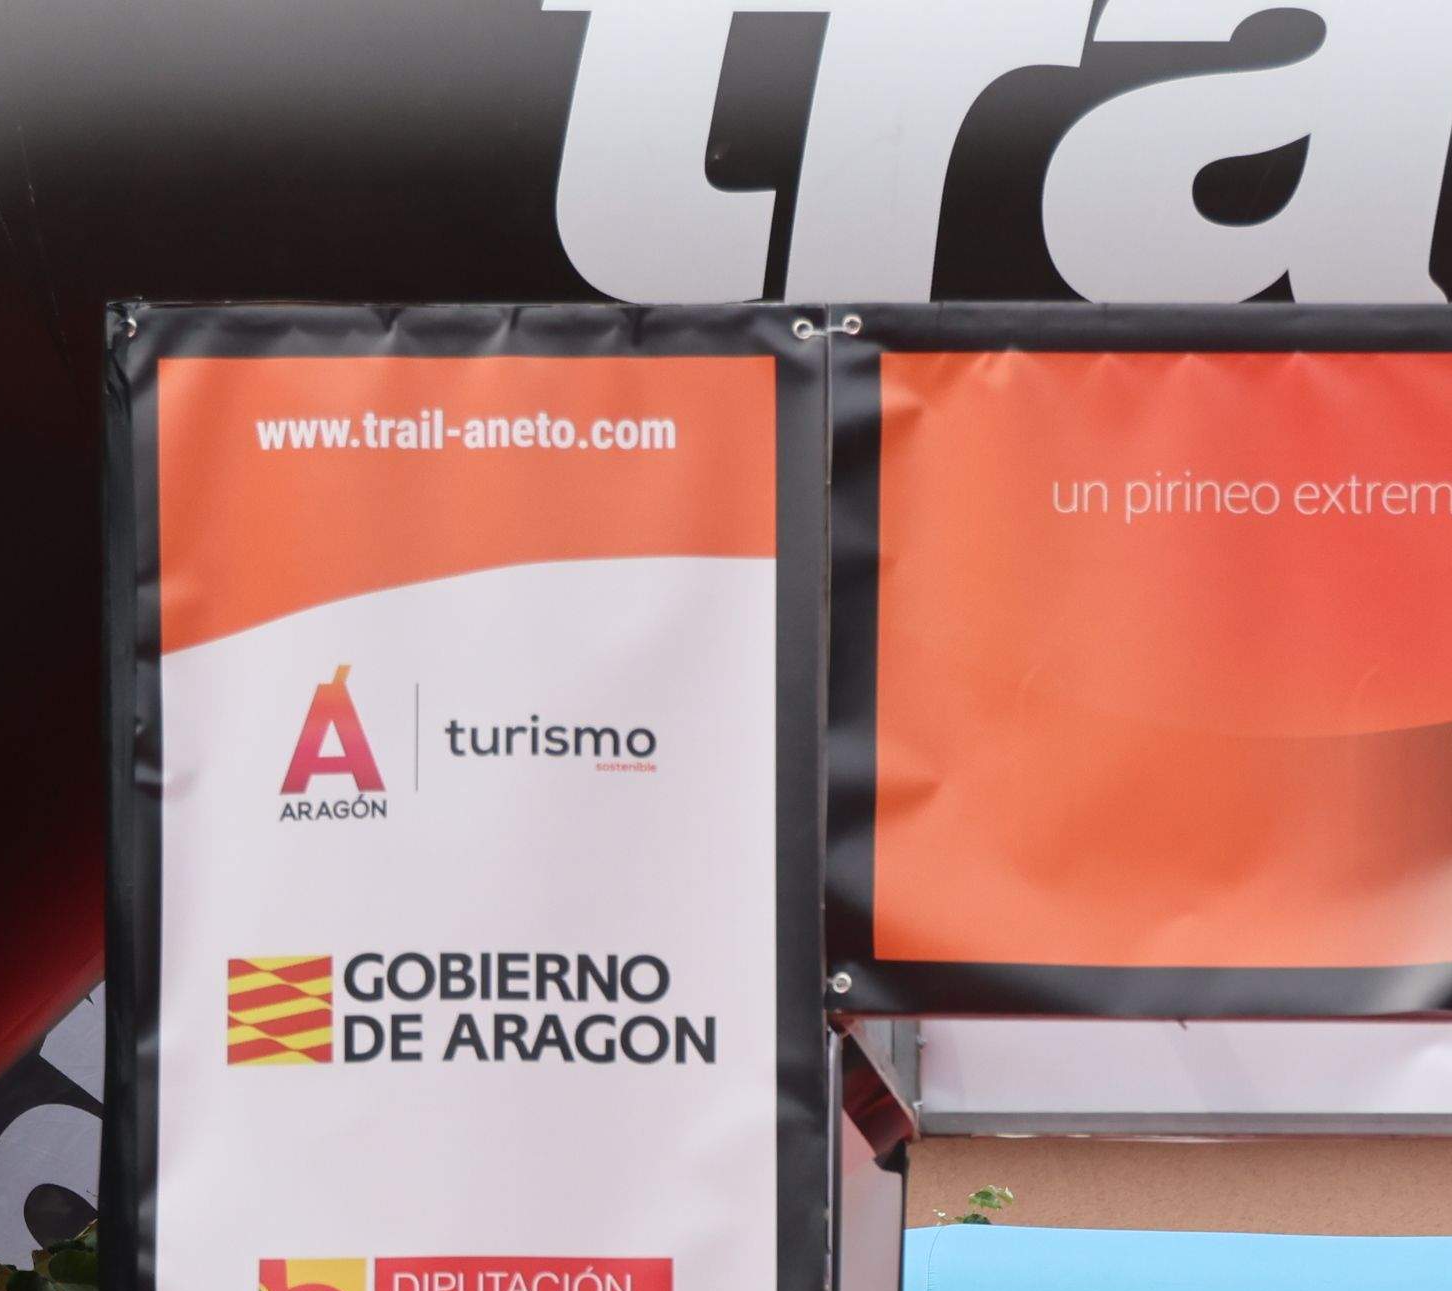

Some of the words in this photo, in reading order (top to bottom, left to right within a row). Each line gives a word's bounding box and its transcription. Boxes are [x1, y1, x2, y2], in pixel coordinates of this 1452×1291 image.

[257, 411, 677, 450] www.trail-aneto.com
[1052, 479, 1109, 514] un
[1125, 471, 1280, 523] pirineo
[445, 715, 657, 758] turismo
[595, 762, 657, 773] sostenible
[280, 794, 387, 822] ARAGÓN
[343, 952, 670, 1003] GOBIERNO
[343, 1014, 423, 1064] DE
[443, 1013, 717, 1065] ARAGON
